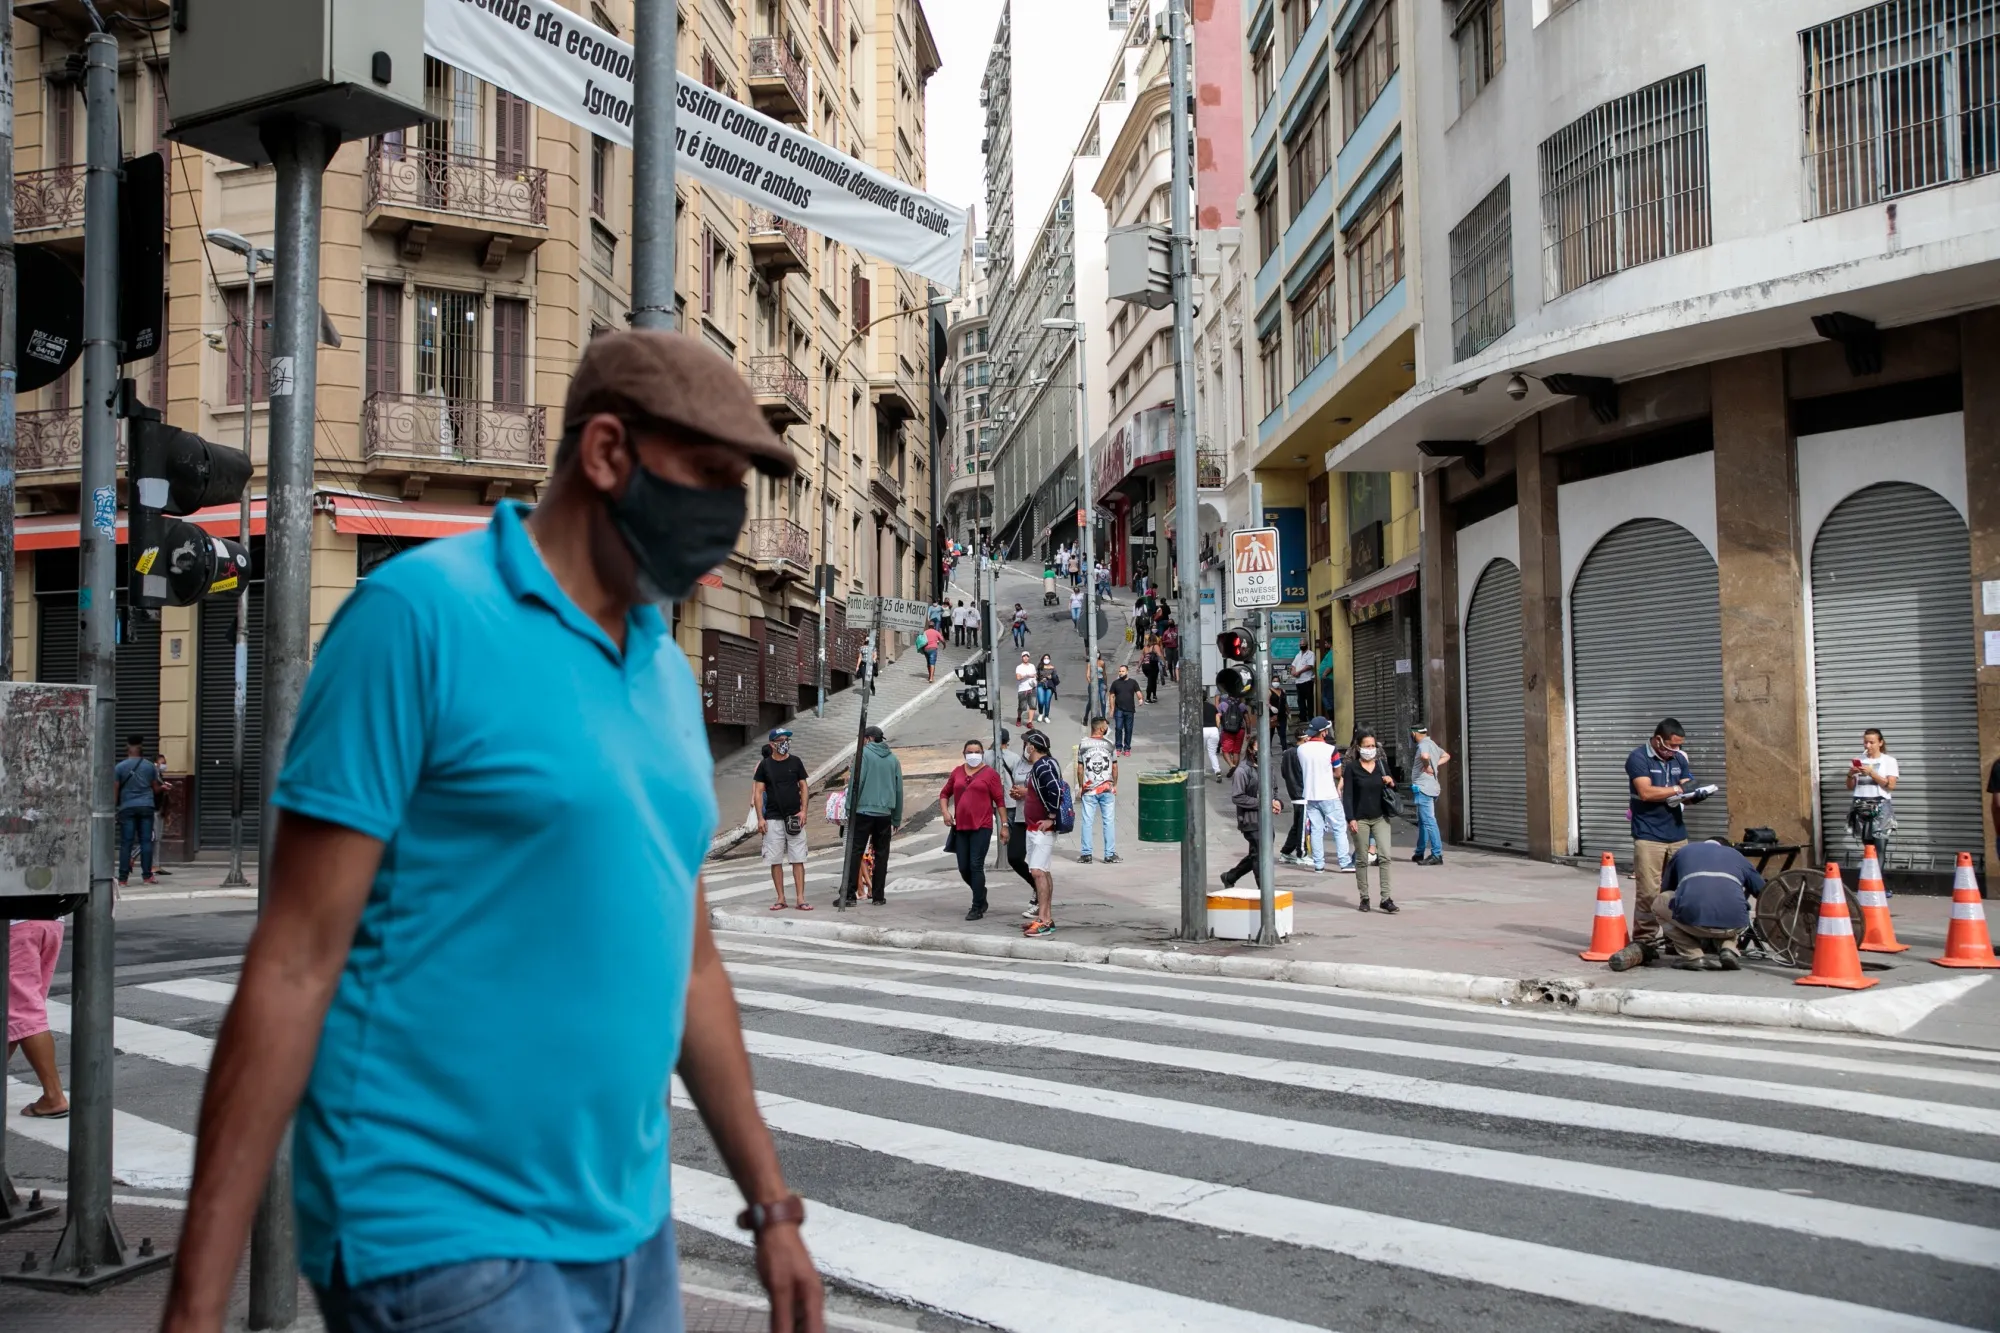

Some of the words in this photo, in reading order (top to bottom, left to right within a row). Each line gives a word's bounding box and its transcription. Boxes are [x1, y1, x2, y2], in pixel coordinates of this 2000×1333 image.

[534, 12, 563, 47] da
[676, 81, 722, 124] ssim
[721, 108, 769, 147] como
[767, 132, 781, 154] a
[779, 137, 851, 188] economia
[846, 171, 900, 213] depende
[899, 195, 916, 221] da
[916, 207, 951, 238] saúde.
[582, 78, 635, 128] Ignor
[686, 130, 703, 157] é
[699, 137, 764, 186] ignorar
[760, 170, 812, 209] ambos
[1236, 585, 1277, 595] ATRAVESSE
[1284, 587, 1305, 596] 123
[847, 596, 862, 609] Porto
[862, 598, 875, 610] Gera
[1251, 594, 1276, 603] VERDE
[883, 599, 893, 612] 25
[894, 600, 905, 613] de
[906, 602, 926, 619] Março
